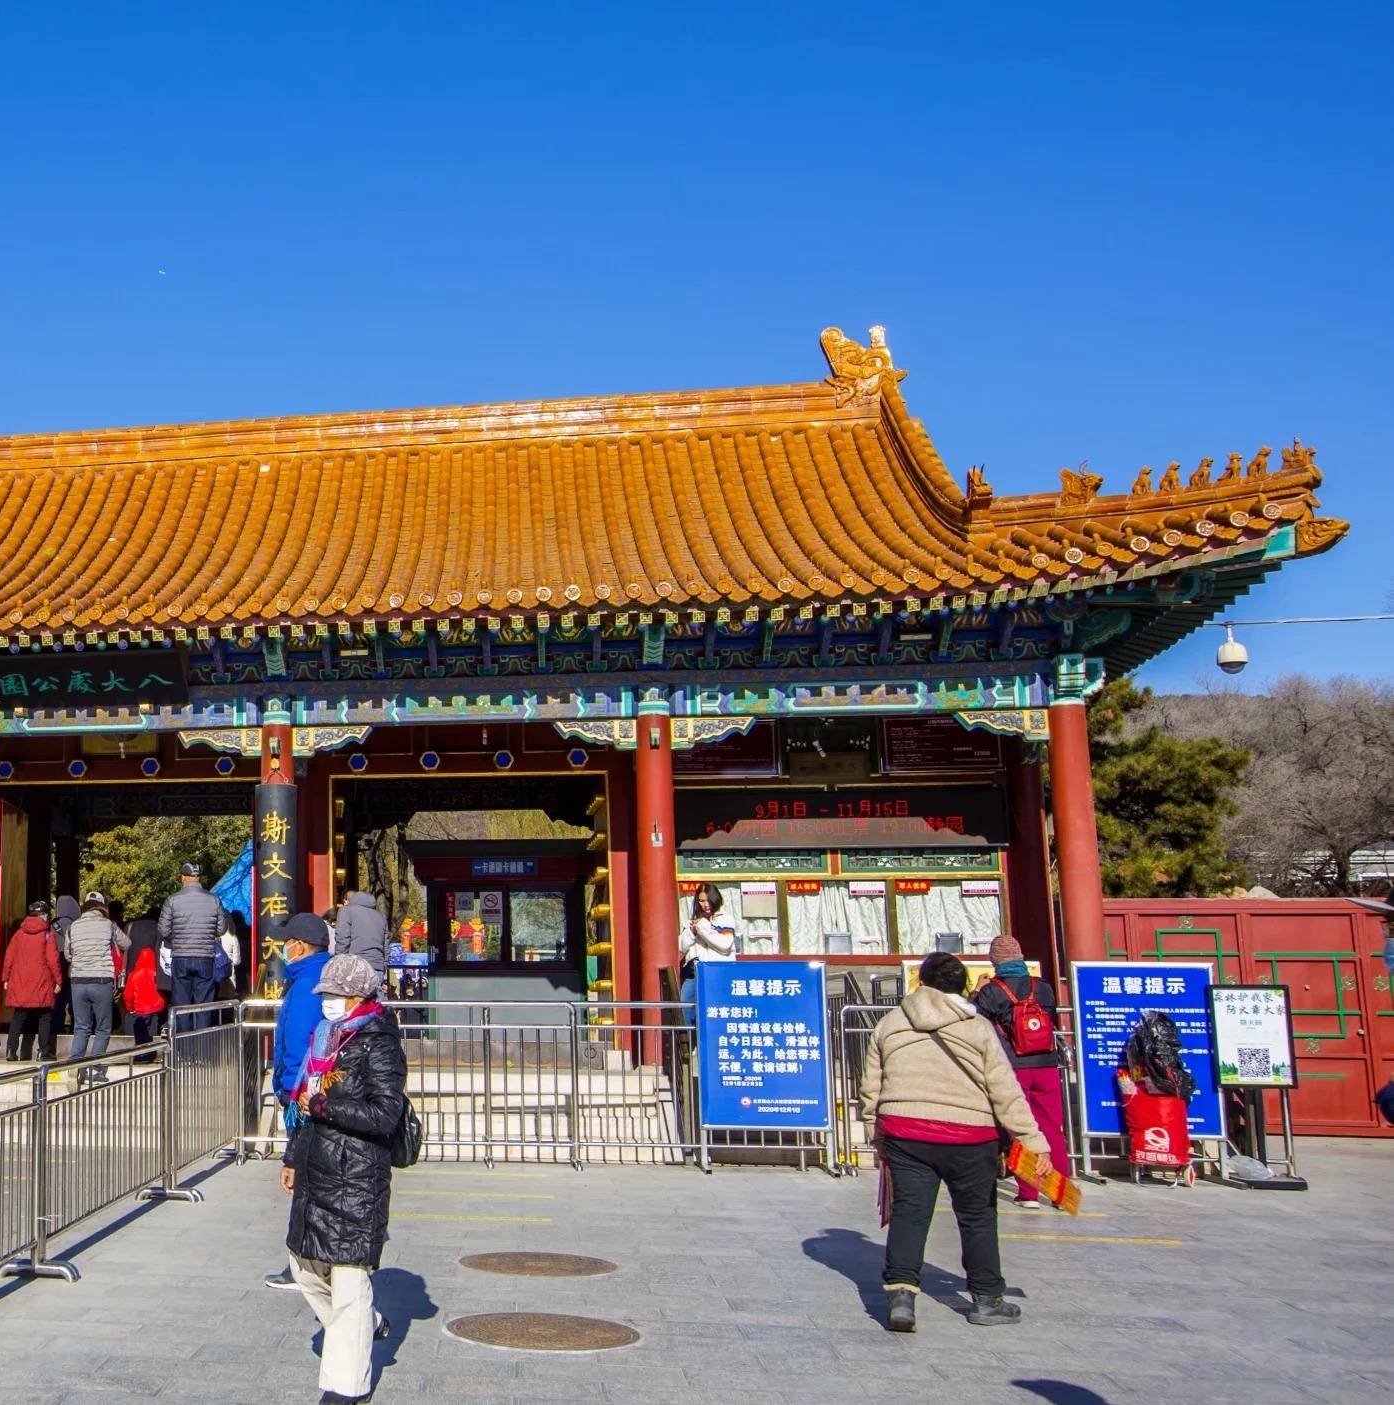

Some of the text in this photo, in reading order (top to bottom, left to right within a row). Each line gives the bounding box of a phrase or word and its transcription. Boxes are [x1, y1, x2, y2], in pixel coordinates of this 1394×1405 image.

[755, 800, 806, 818] 9月1日
[837, 800, 908, 817] 11月15日
[731, 979, 801, 996] 温馨提示
[1103, 976, 1186, 995] 温馨提示
